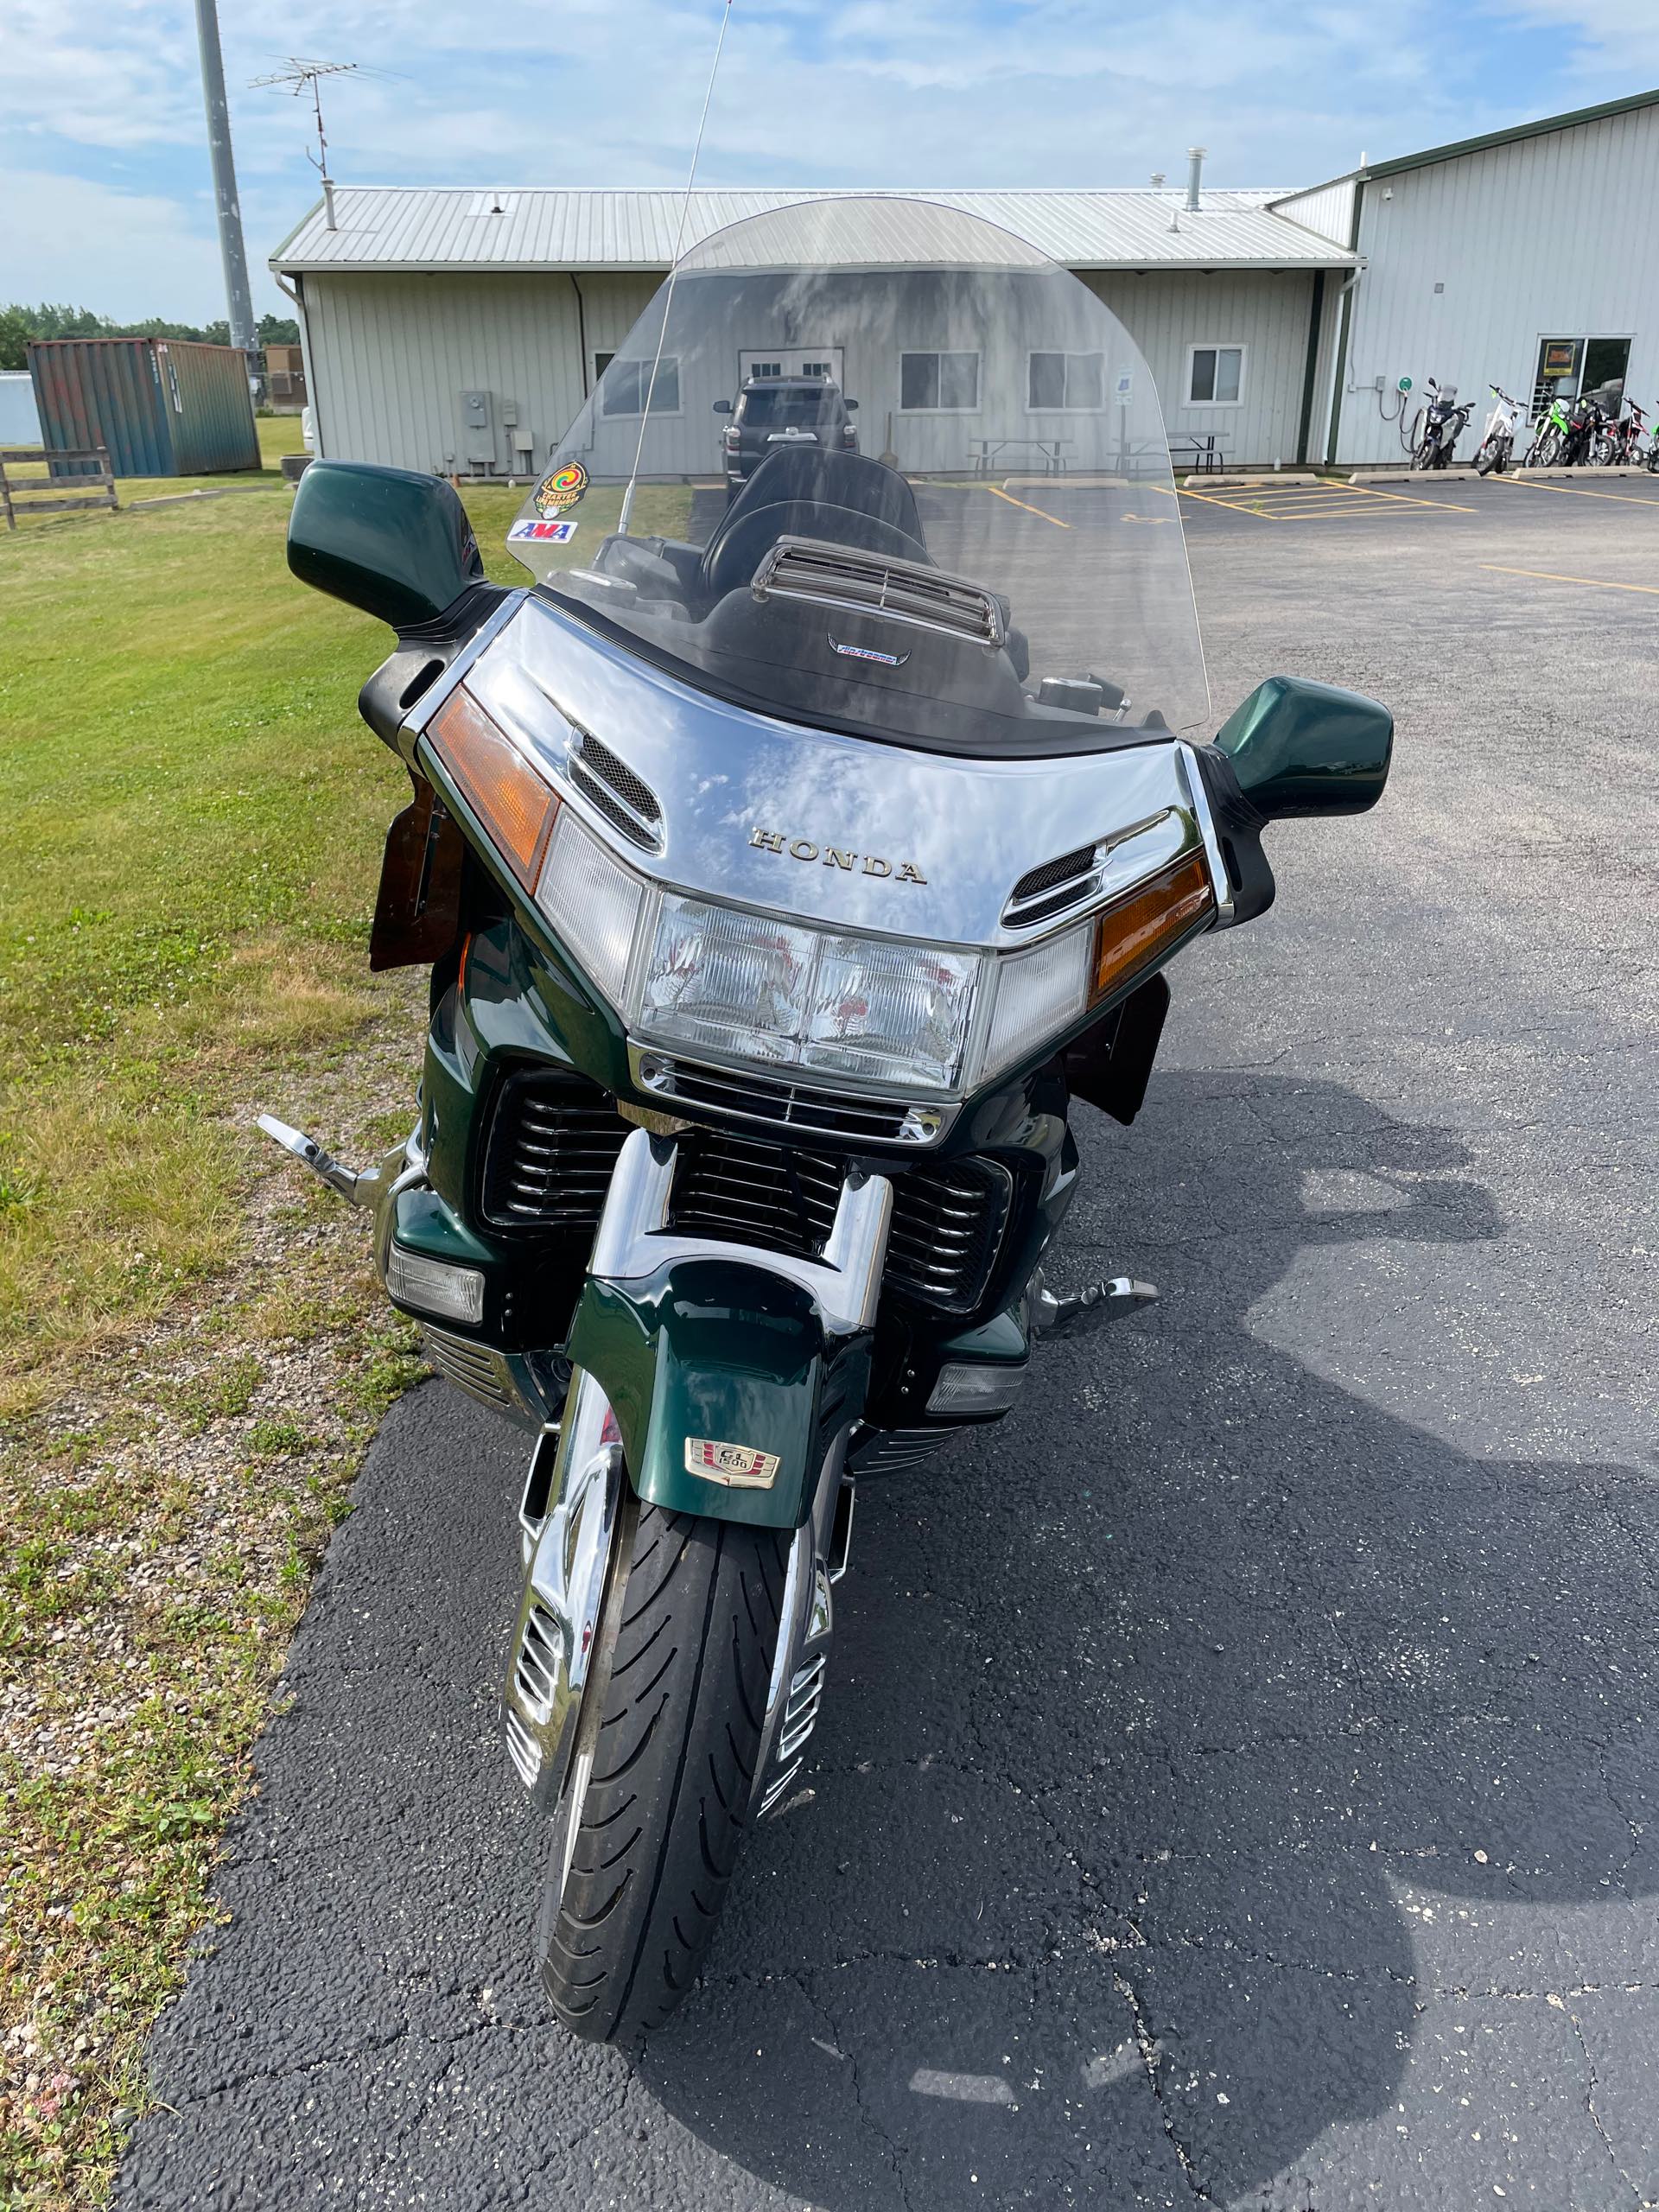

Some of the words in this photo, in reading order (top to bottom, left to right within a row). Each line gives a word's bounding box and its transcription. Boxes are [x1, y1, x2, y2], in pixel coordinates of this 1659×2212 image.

[542, 492, 577, 500] CHARTER
[511, 523, 571, 539] AMA
[747, 826, 928, 885] HONDA
[721, 1450, 747, 1463] GL
[719, 1458, 747, 1469] 1500
